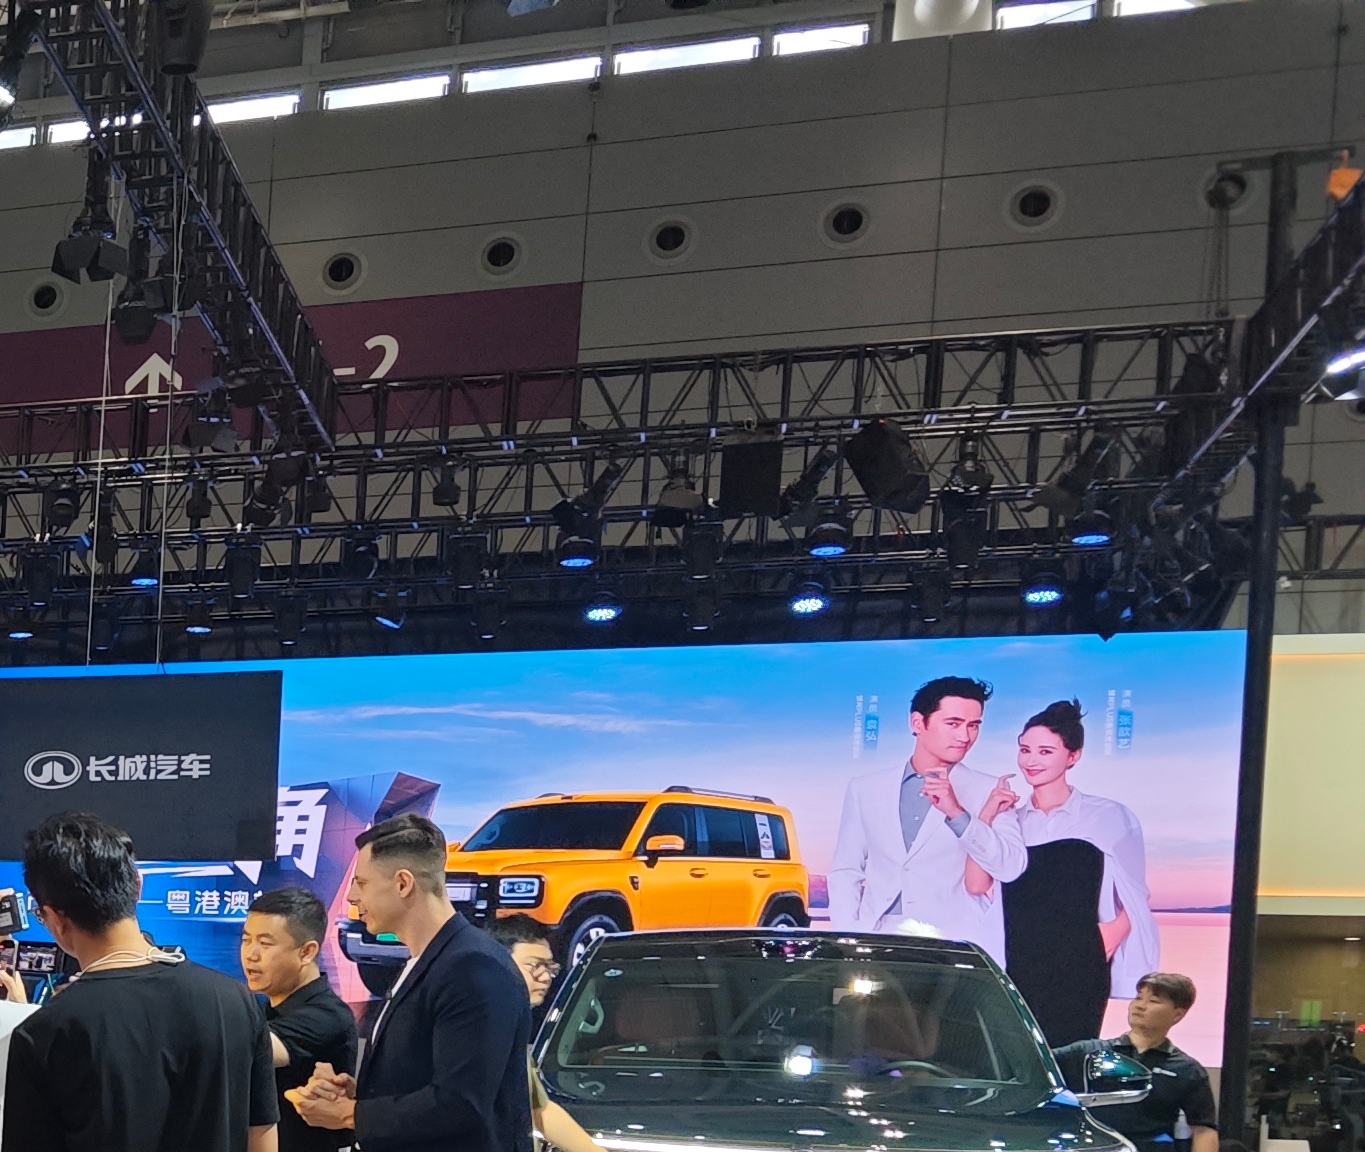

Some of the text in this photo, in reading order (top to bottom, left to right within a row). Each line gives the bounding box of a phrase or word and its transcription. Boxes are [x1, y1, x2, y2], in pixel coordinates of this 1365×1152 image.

[86, 753, 211, 782] 长城汽车
[166, 889, 262, 915] 粤港澳
